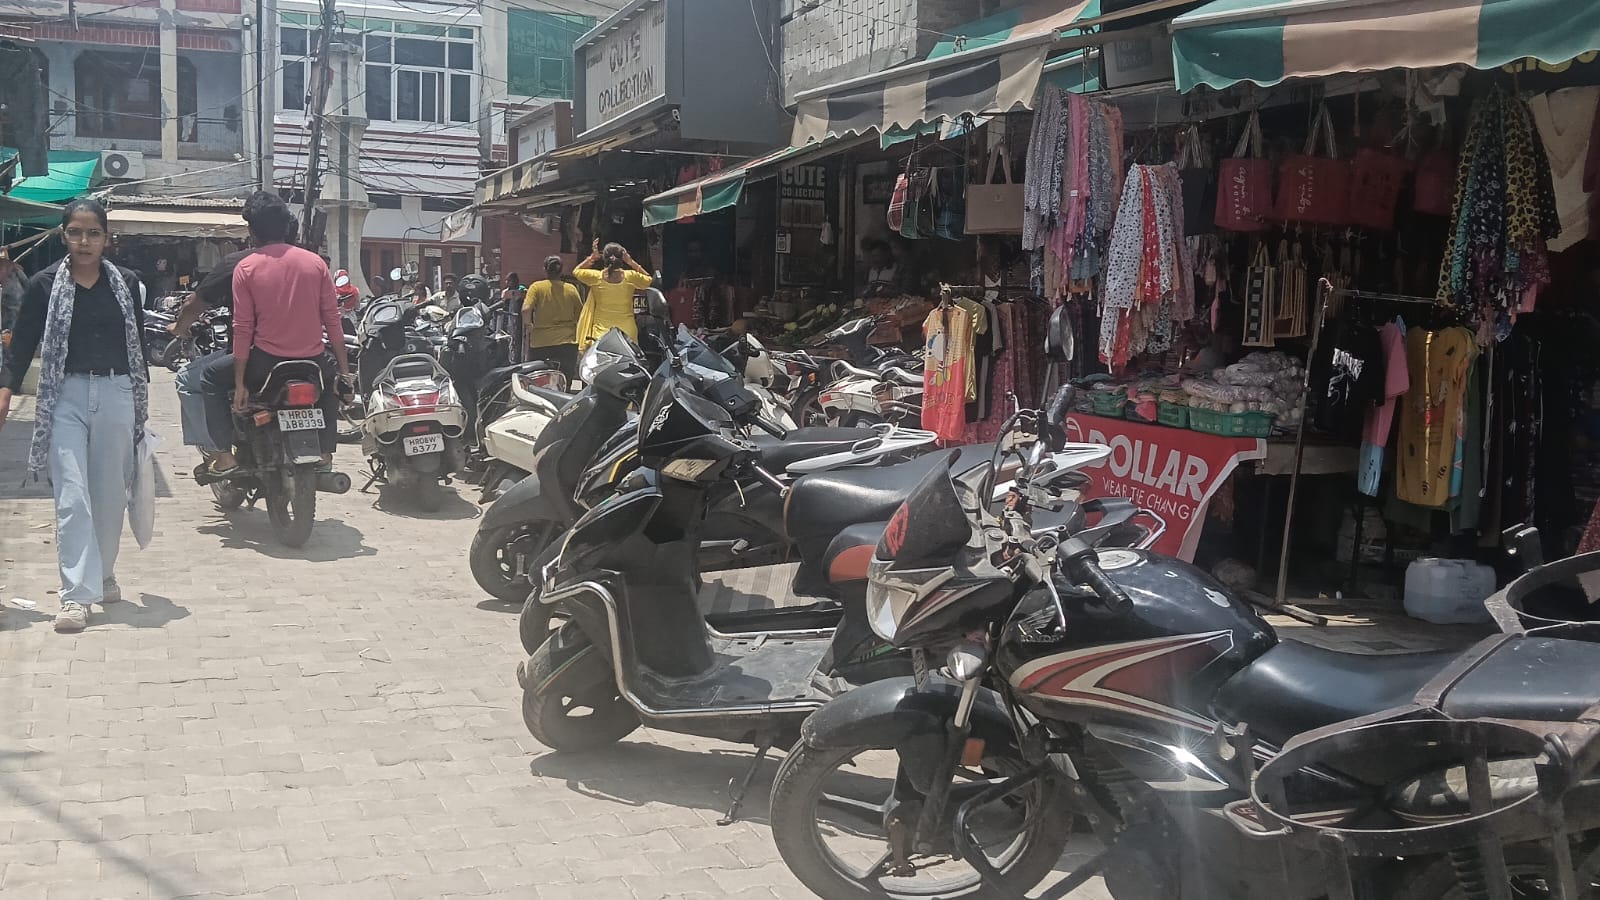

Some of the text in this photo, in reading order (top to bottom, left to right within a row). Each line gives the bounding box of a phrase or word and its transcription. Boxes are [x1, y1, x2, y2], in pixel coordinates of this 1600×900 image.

[598, 65, 655, 114] COLLECTION
[781, 165, 826, 187] CUTE
[781, 186, 825, 199] COLECTION
[287, 410, 314, 420] HR08
[285, 419, 324, 430] AB8339
[1088, 429, 1209, 502] DOLLAR
